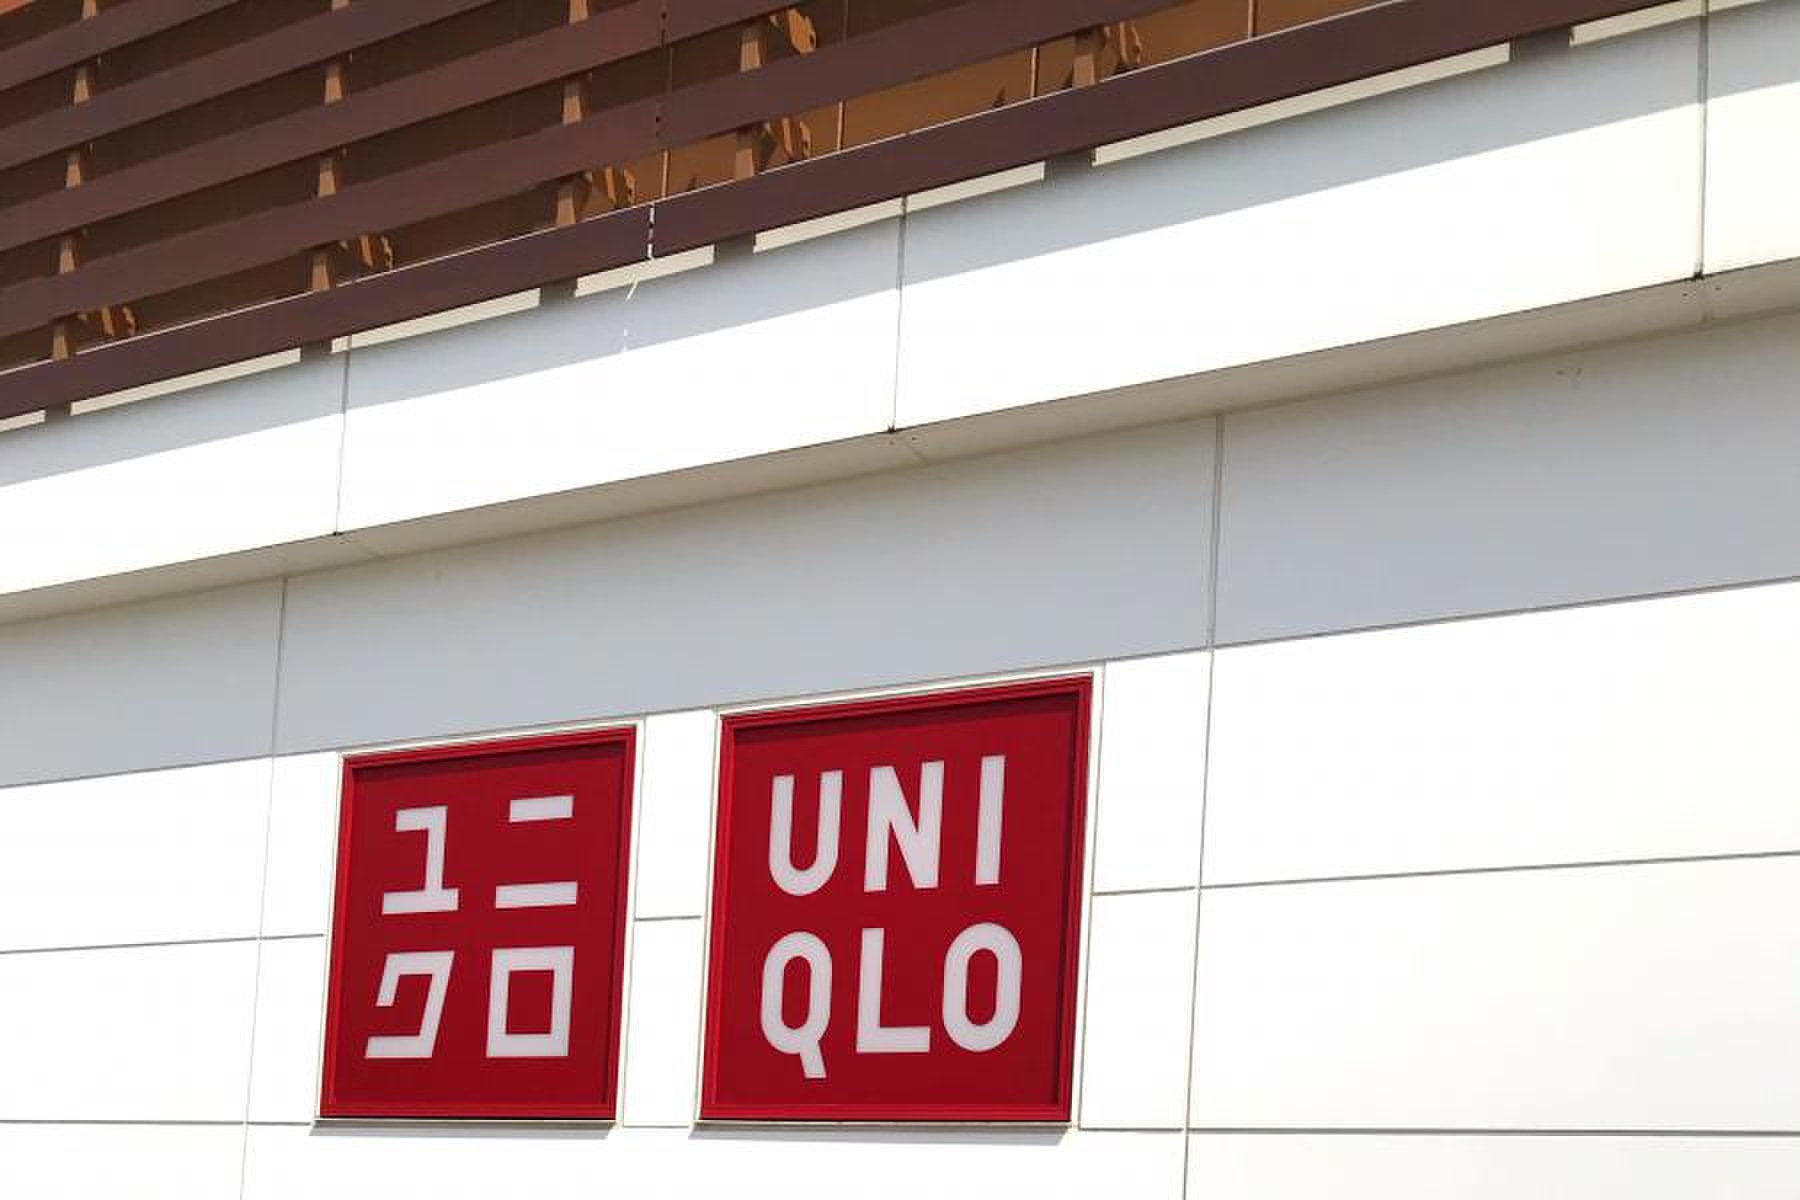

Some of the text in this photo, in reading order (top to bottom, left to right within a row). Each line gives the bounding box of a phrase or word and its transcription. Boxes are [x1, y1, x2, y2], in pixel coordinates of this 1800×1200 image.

[381, 794, 579, 915] ユニ
[769, 754, 1006, 897] UNI
[365, 945, 576, 1059] クロ
[761, 922, 1023, 1079] QLO
